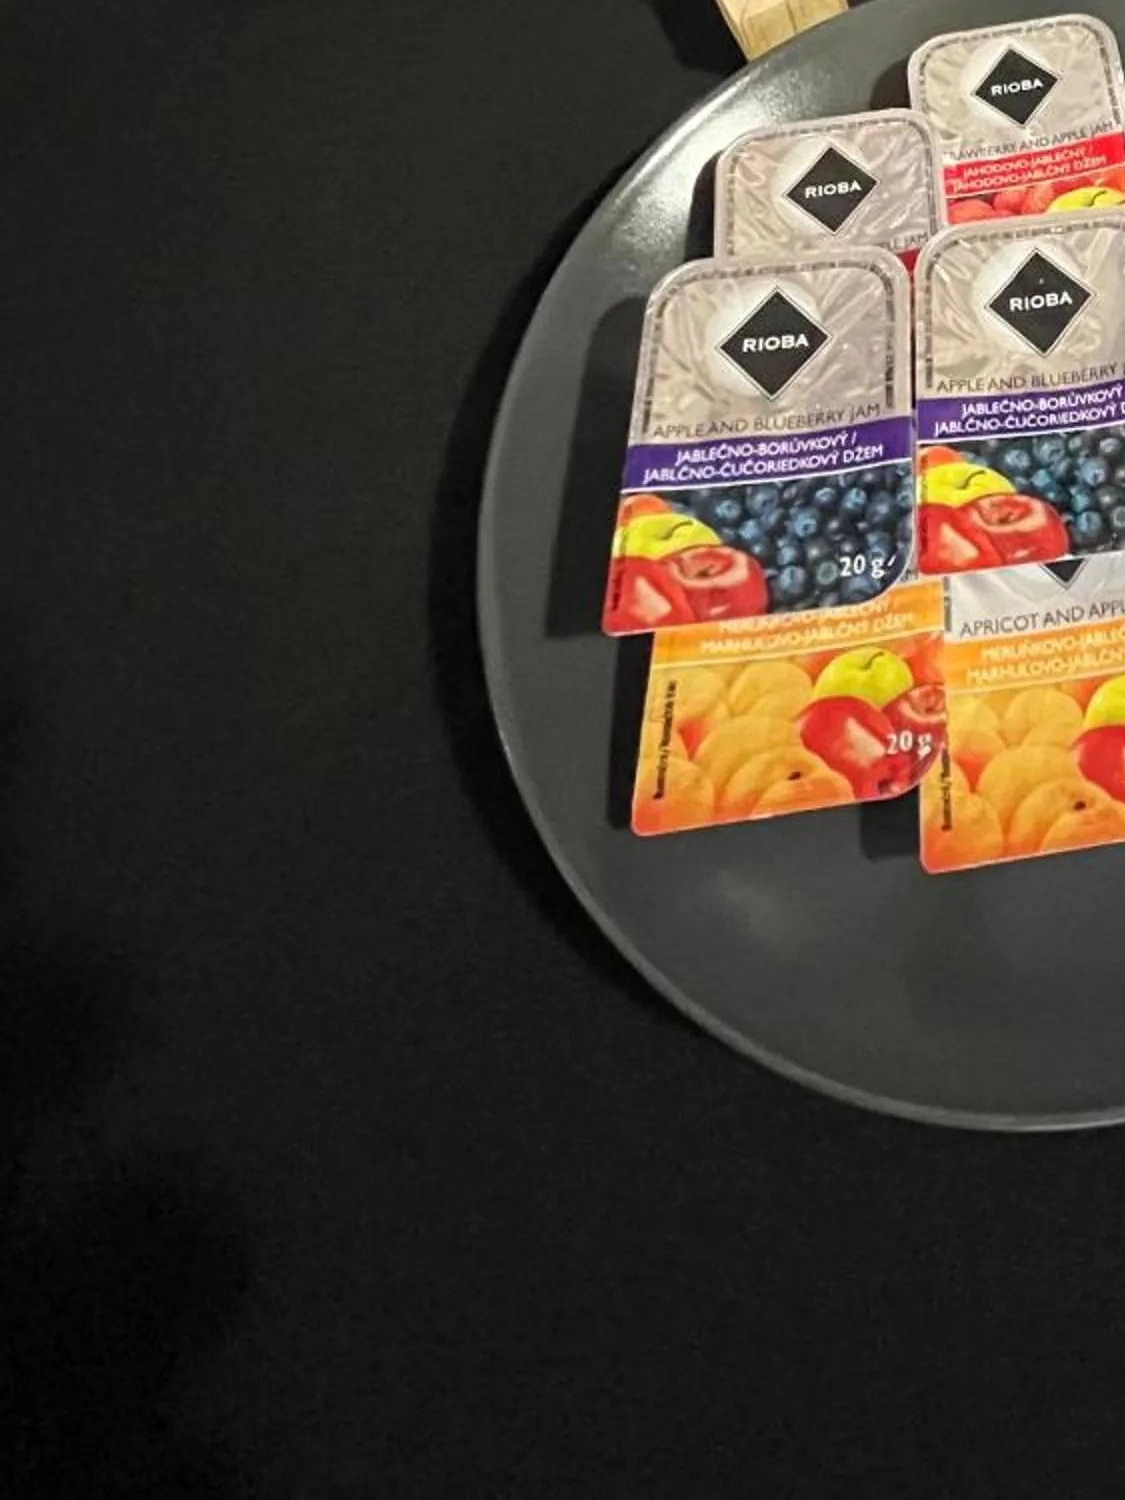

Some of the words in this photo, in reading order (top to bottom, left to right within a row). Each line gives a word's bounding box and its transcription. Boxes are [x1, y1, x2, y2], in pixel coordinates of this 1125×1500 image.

[990, 77, 1045, 97] RIOBA
[804, 180, 862, 200] RIOBA
[1008, 290, 1073, 312] RIOBA
[742, 333, 809, 353] RIOBA
[935, 377, 985, 394] APPLE
[988, 373, 1027, 391] AND
[1031, 362, 1119, 388] BLUEBERRY
[652, 420, 708, 441] APPLE
[709, 417, 749, 437] AND
[752, 407, 846, 431] BLUEBERRY
[848, 402, 881, 423] JAM
[839, 554, 865, 577] 20
[959, 611, 1039, 638] APRICOT
[1042, 604, 1085, 628] AND
[886, 730, 913, 755] 20
